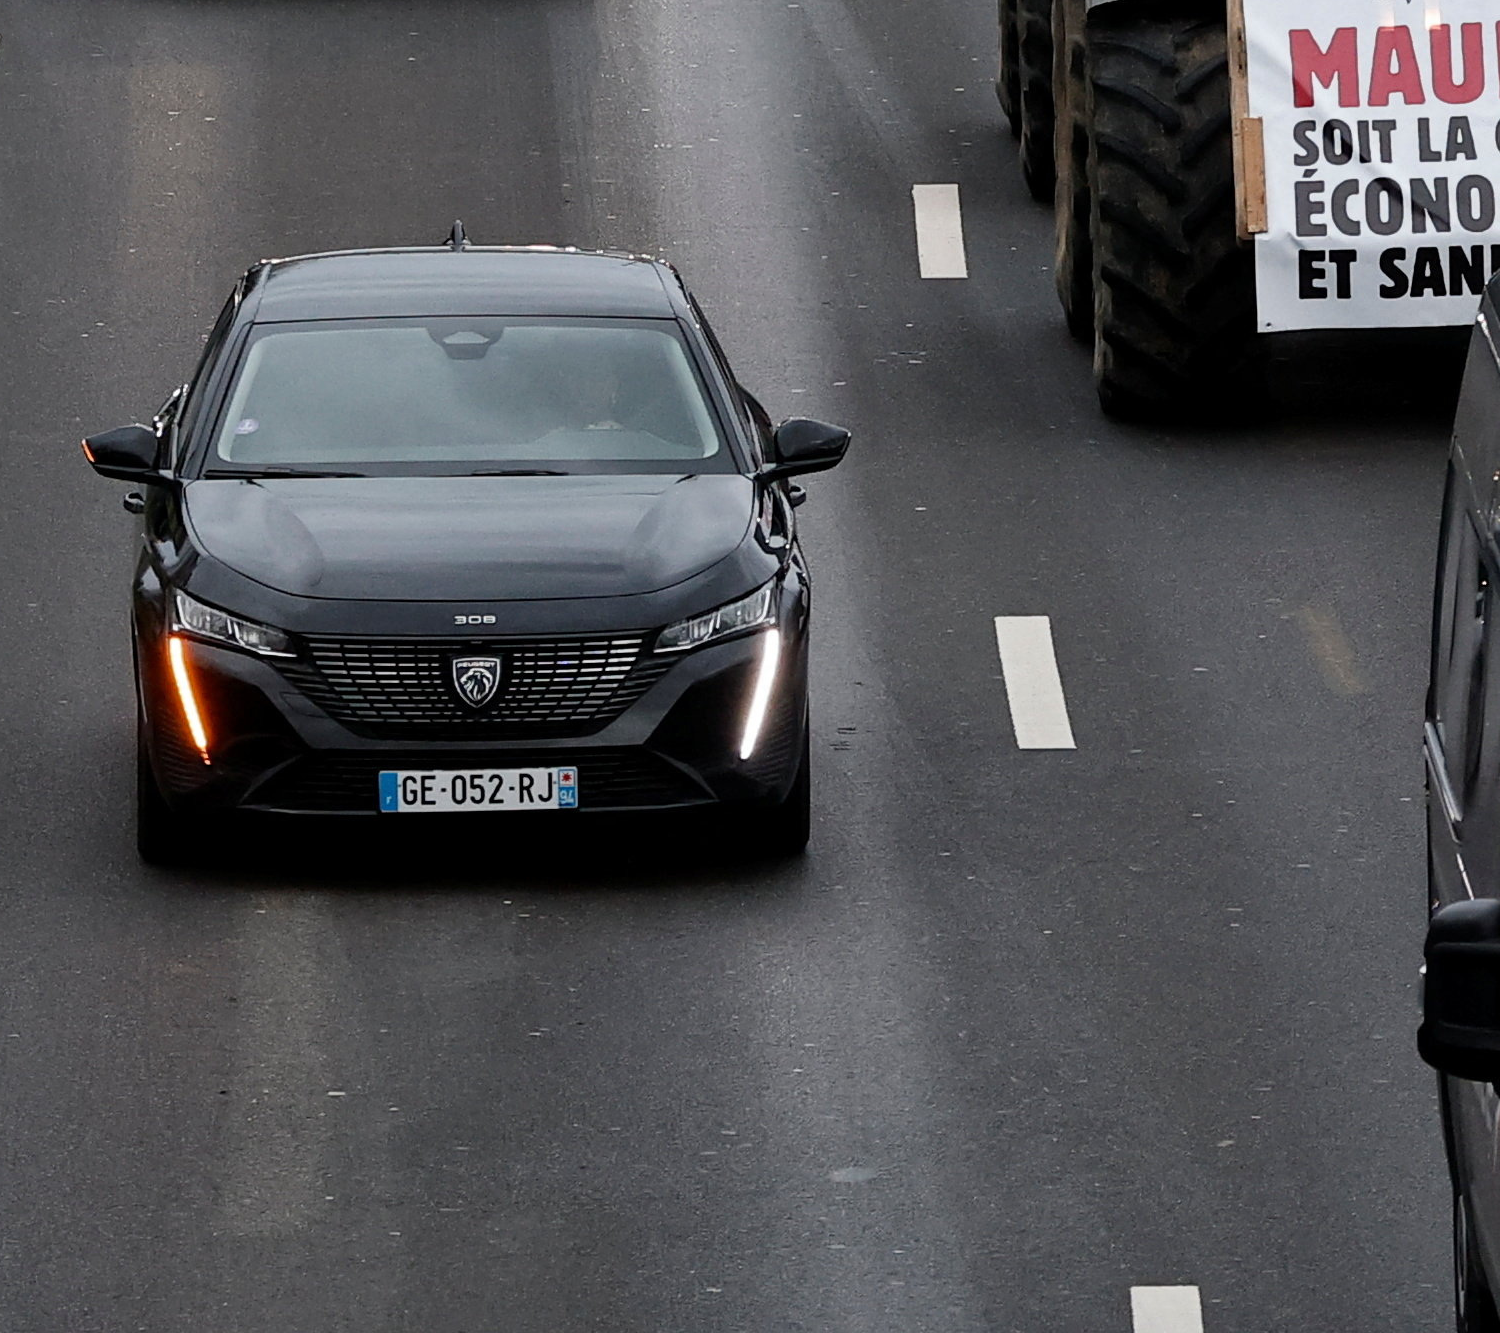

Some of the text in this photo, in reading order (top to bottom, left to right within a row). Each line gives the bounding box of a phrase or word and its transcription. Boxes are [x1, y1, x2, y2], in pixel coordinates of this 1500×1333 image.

[1293, 118, 1397, 167] SOIT
[1417, 115, 1478, 163] LA
[1298, 248, 1358, 300] ET
[454, 615, 497, 625] 308
[402, 772, 553, 806] GE-052-RJ
